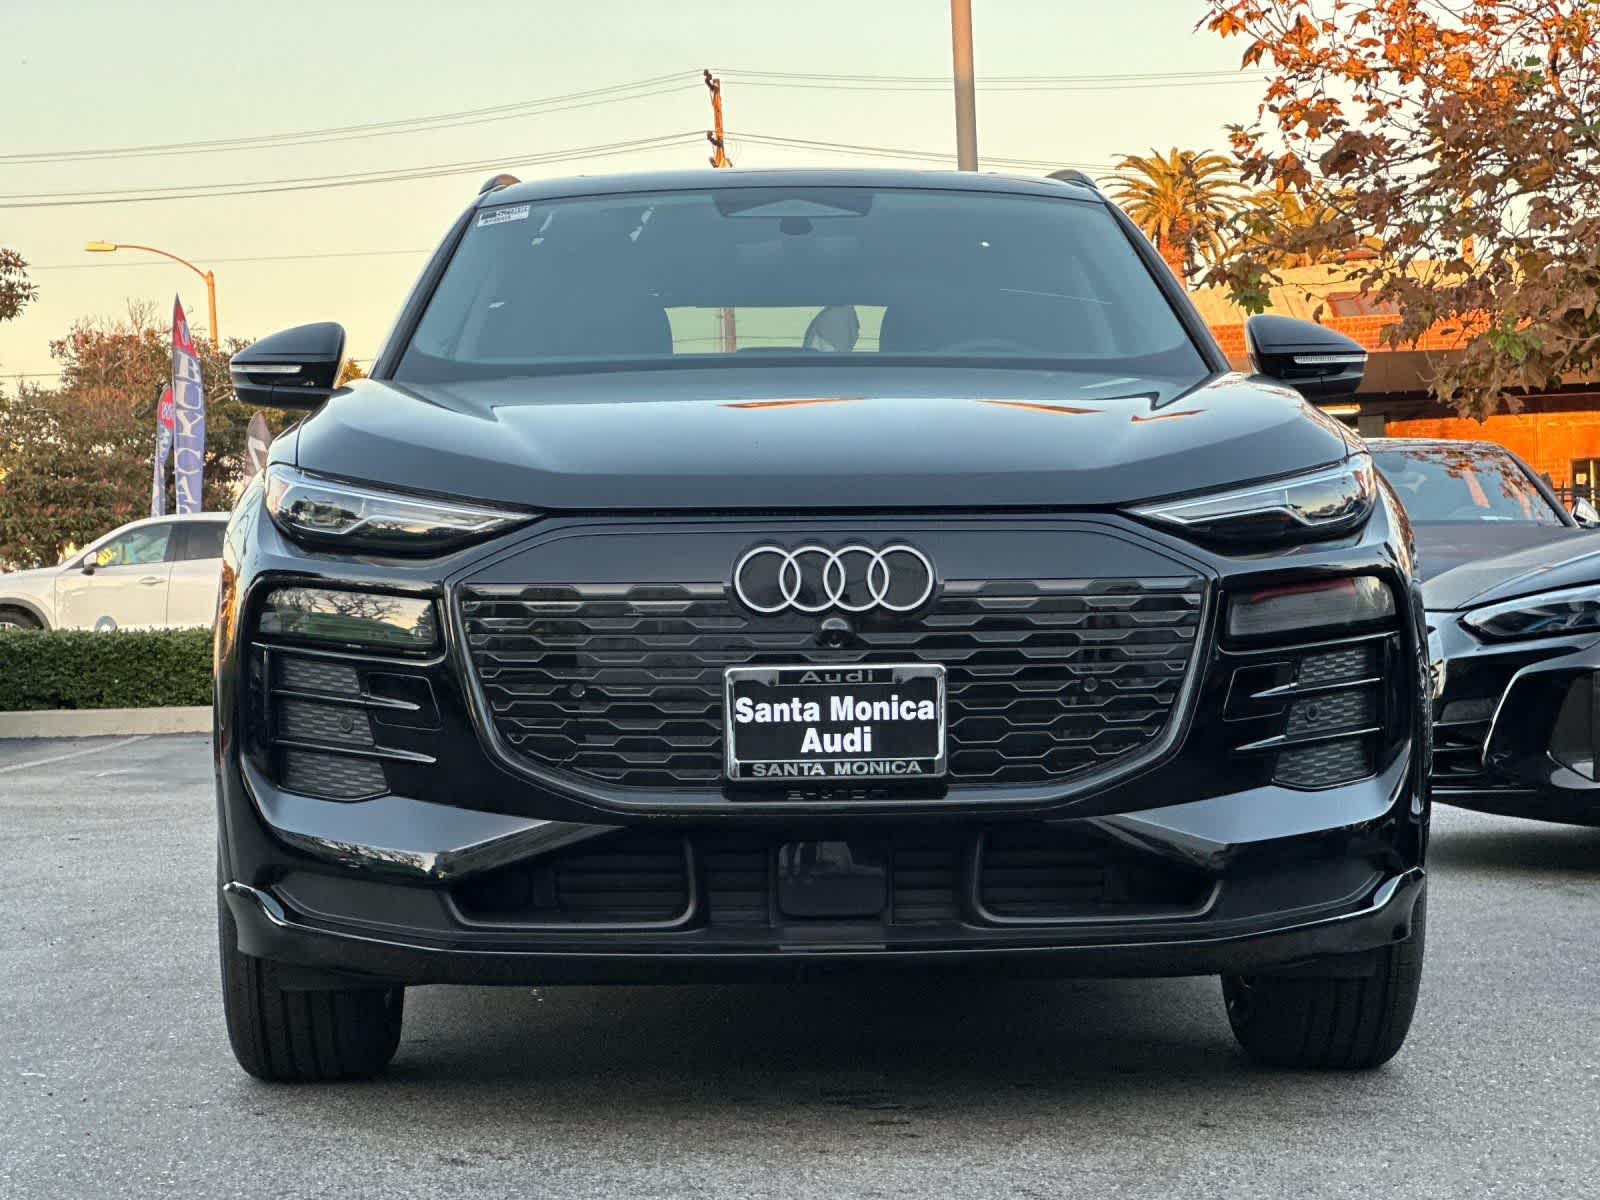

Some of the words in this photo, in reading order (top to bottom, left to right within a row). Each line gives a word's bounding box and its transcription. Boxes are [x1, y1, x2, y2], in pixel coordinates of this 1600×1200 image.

[799, 669, 873, 683] Audi
[735, 696, 821, 723] Santa
[830, 694, 935, 721] Monica
[800, 726, 872, 753] Audi
[751, 762, 826, 777] SANTA
[833, 760, 923, 776] MONICA
